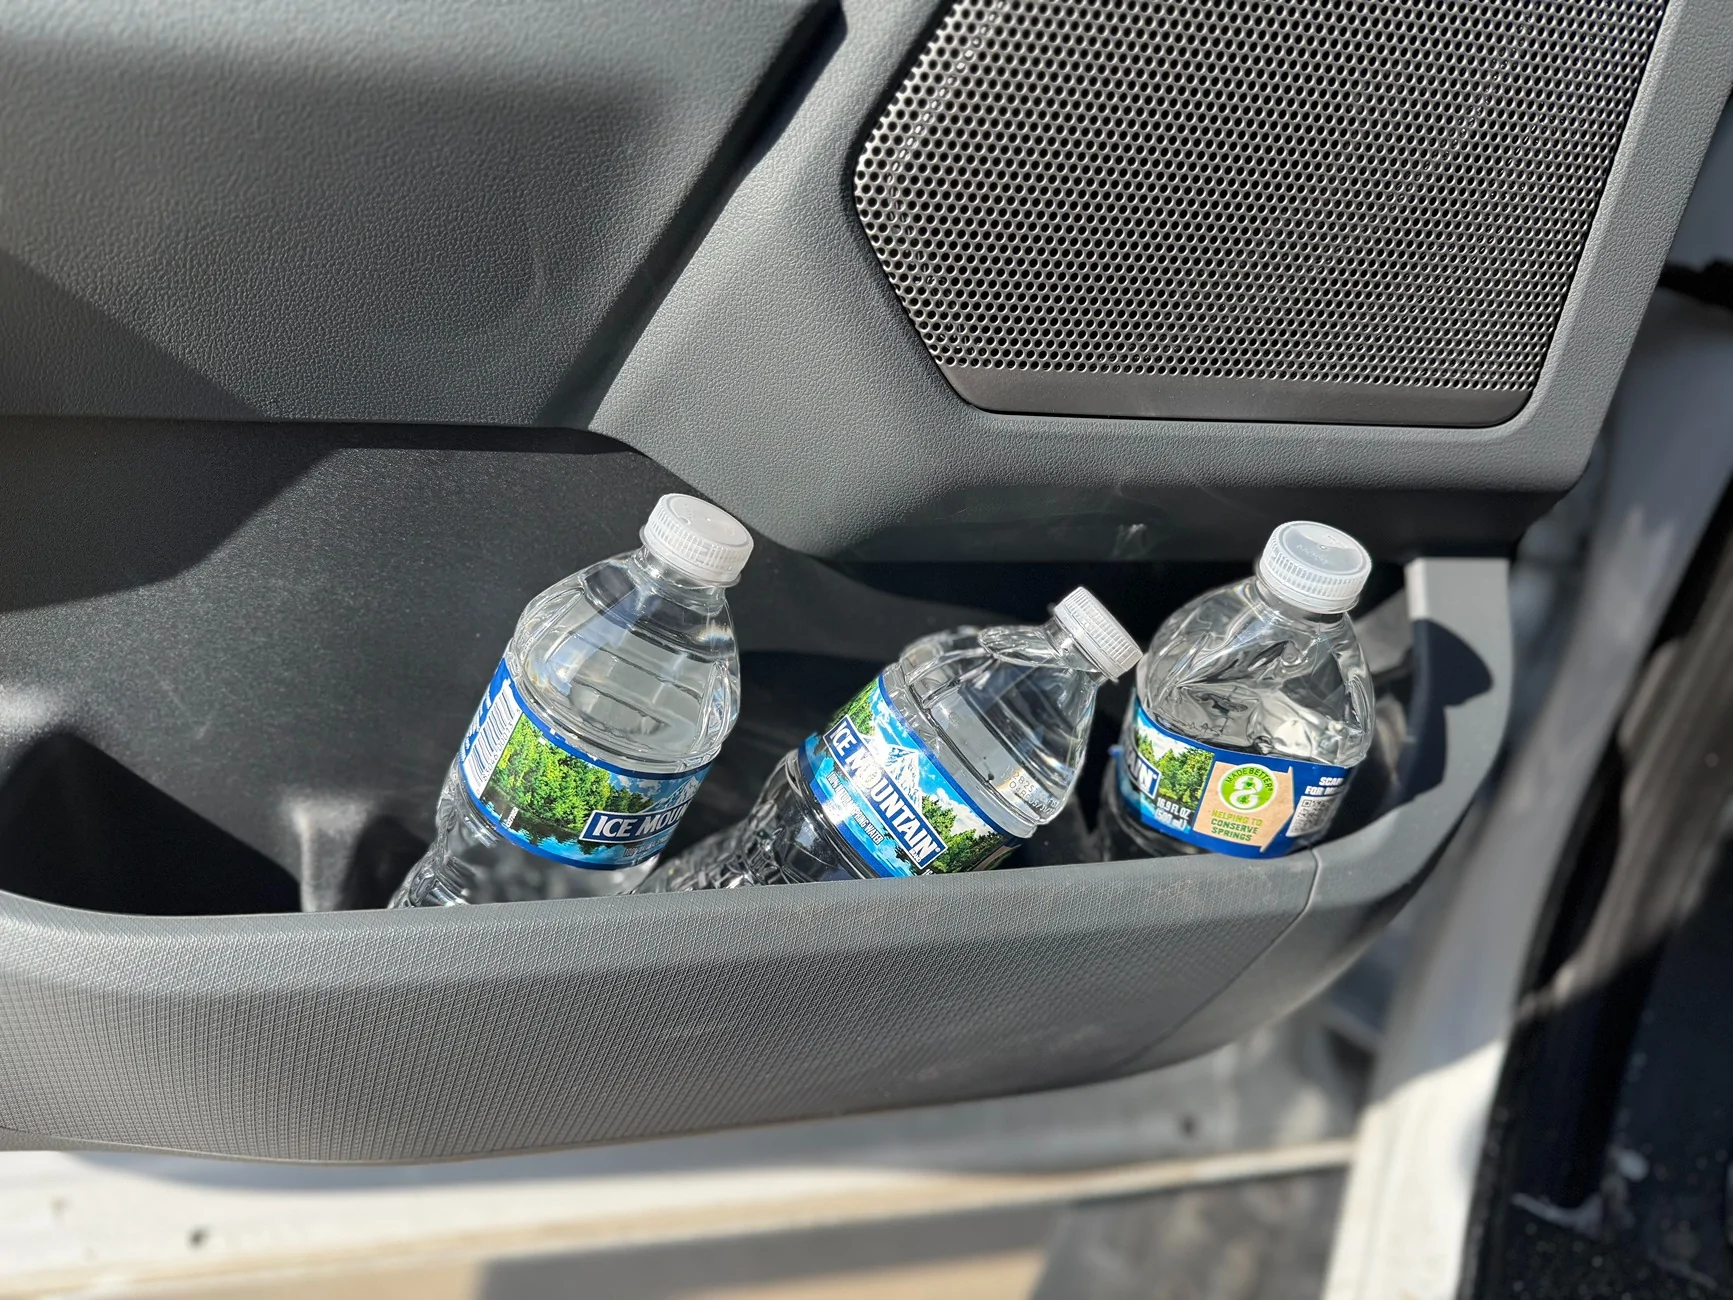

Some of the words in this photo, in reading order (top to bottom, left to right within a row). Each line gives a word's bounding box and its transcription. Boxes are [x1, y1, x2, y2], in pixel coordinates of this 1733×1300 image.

[1226, 768, 1247, 783] MADE
[1249, 768, 1272, 788] BETTER
[829, 721, 858, 757] ICE
[845, 746, 938, 860] MOUNTAIN
[1305, 786, 1325, 795] FOR
[1156, 797, 1171, 811] 16.9
[1170, 803, 1178, 814] FL
[1179, 807, 1191, 819] OZ
[1212, 810, 1249, 823] HELPING
[1252, 818, 1262, 826] TO
[592, 815, 638, 837] ICE
[863, 822, 883, 844] WATER
[1211, 818, 1258, 834] CONSERVE
[1211, 827, 1252, 841] SPRINGS
